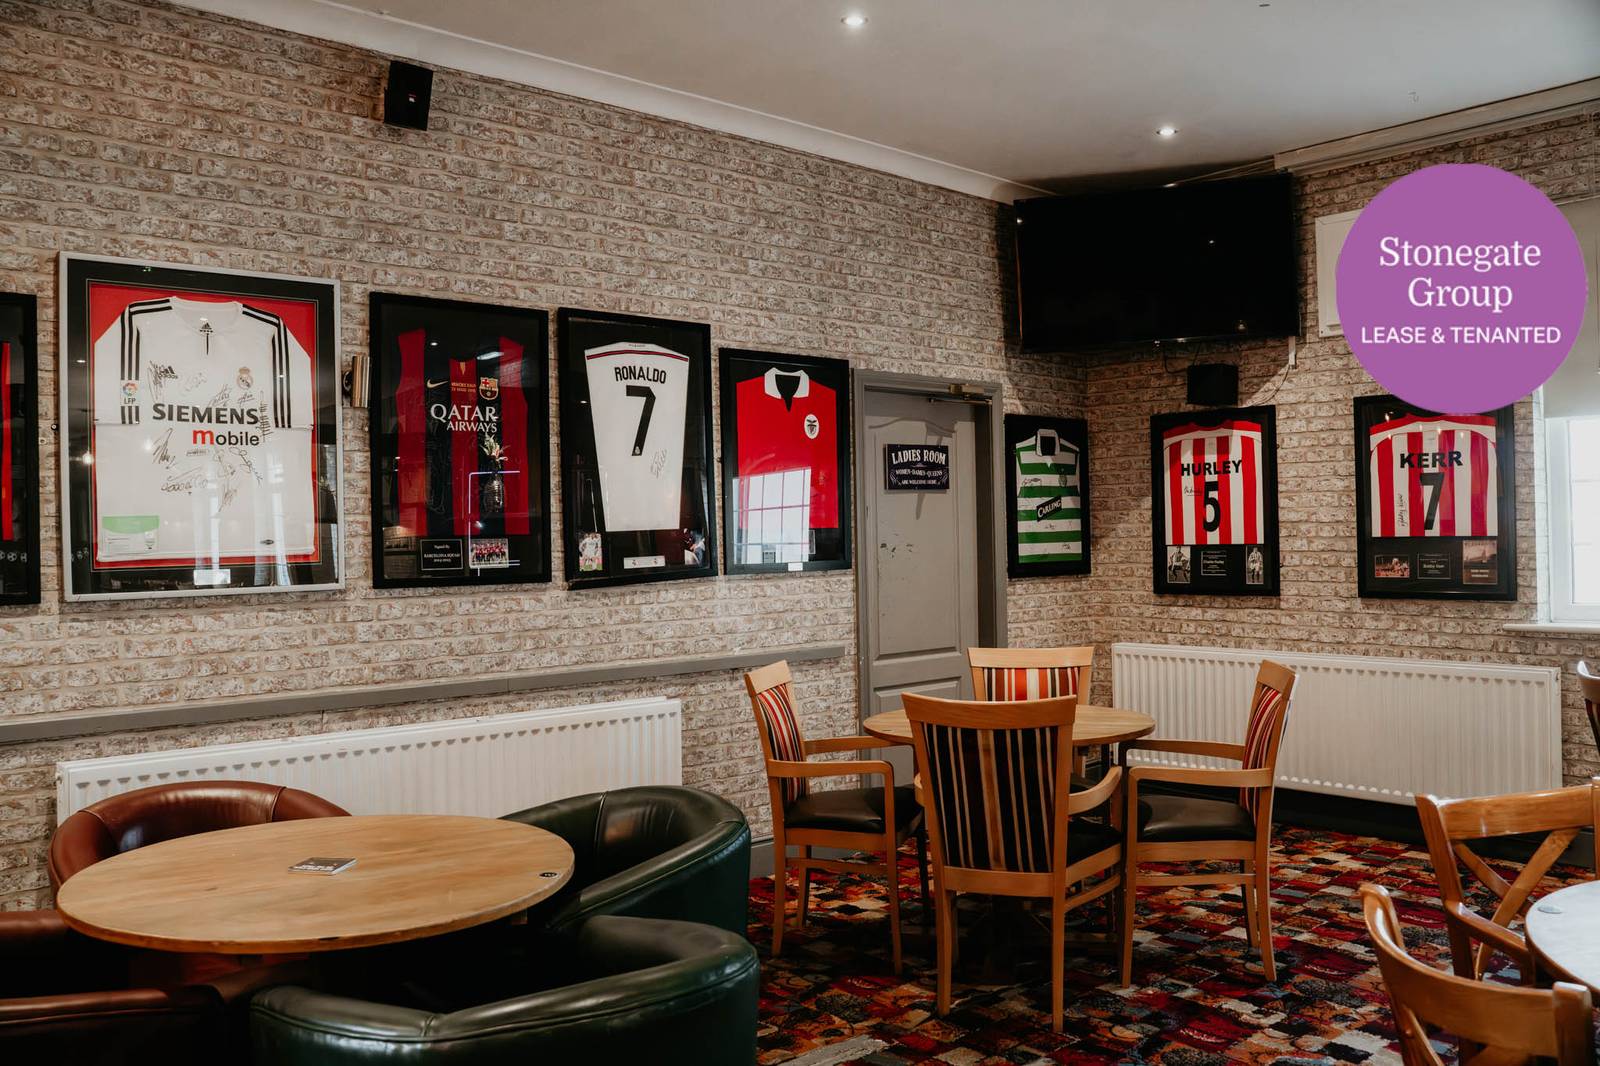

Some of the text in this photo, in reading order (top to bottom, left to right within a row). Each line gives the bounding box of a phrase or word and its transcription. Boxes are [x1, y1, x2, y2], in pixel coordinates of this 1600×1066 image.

[614, 365, 667, 384] RONALDO
[124, 397, 136, 405] LFP
[152, 403, 260, 425] SIEMENS
[430, 403, 498, 423] QATAR
[625, 385, 656, 456] 7
[446, 421, 498, 433] AIRWAYS
[192, 429, 260, 446] mobile
[891, 449, 947, 465] LADIES ROOM
[1399, 451, 1464, 469] KERR
[1181, 459, 1242, 477] HURLEY
[1037, 499, 1061, 518] CARLING
[1202, 481, 1221, 533] 5
[1419, 472, 1446, 531] 7
